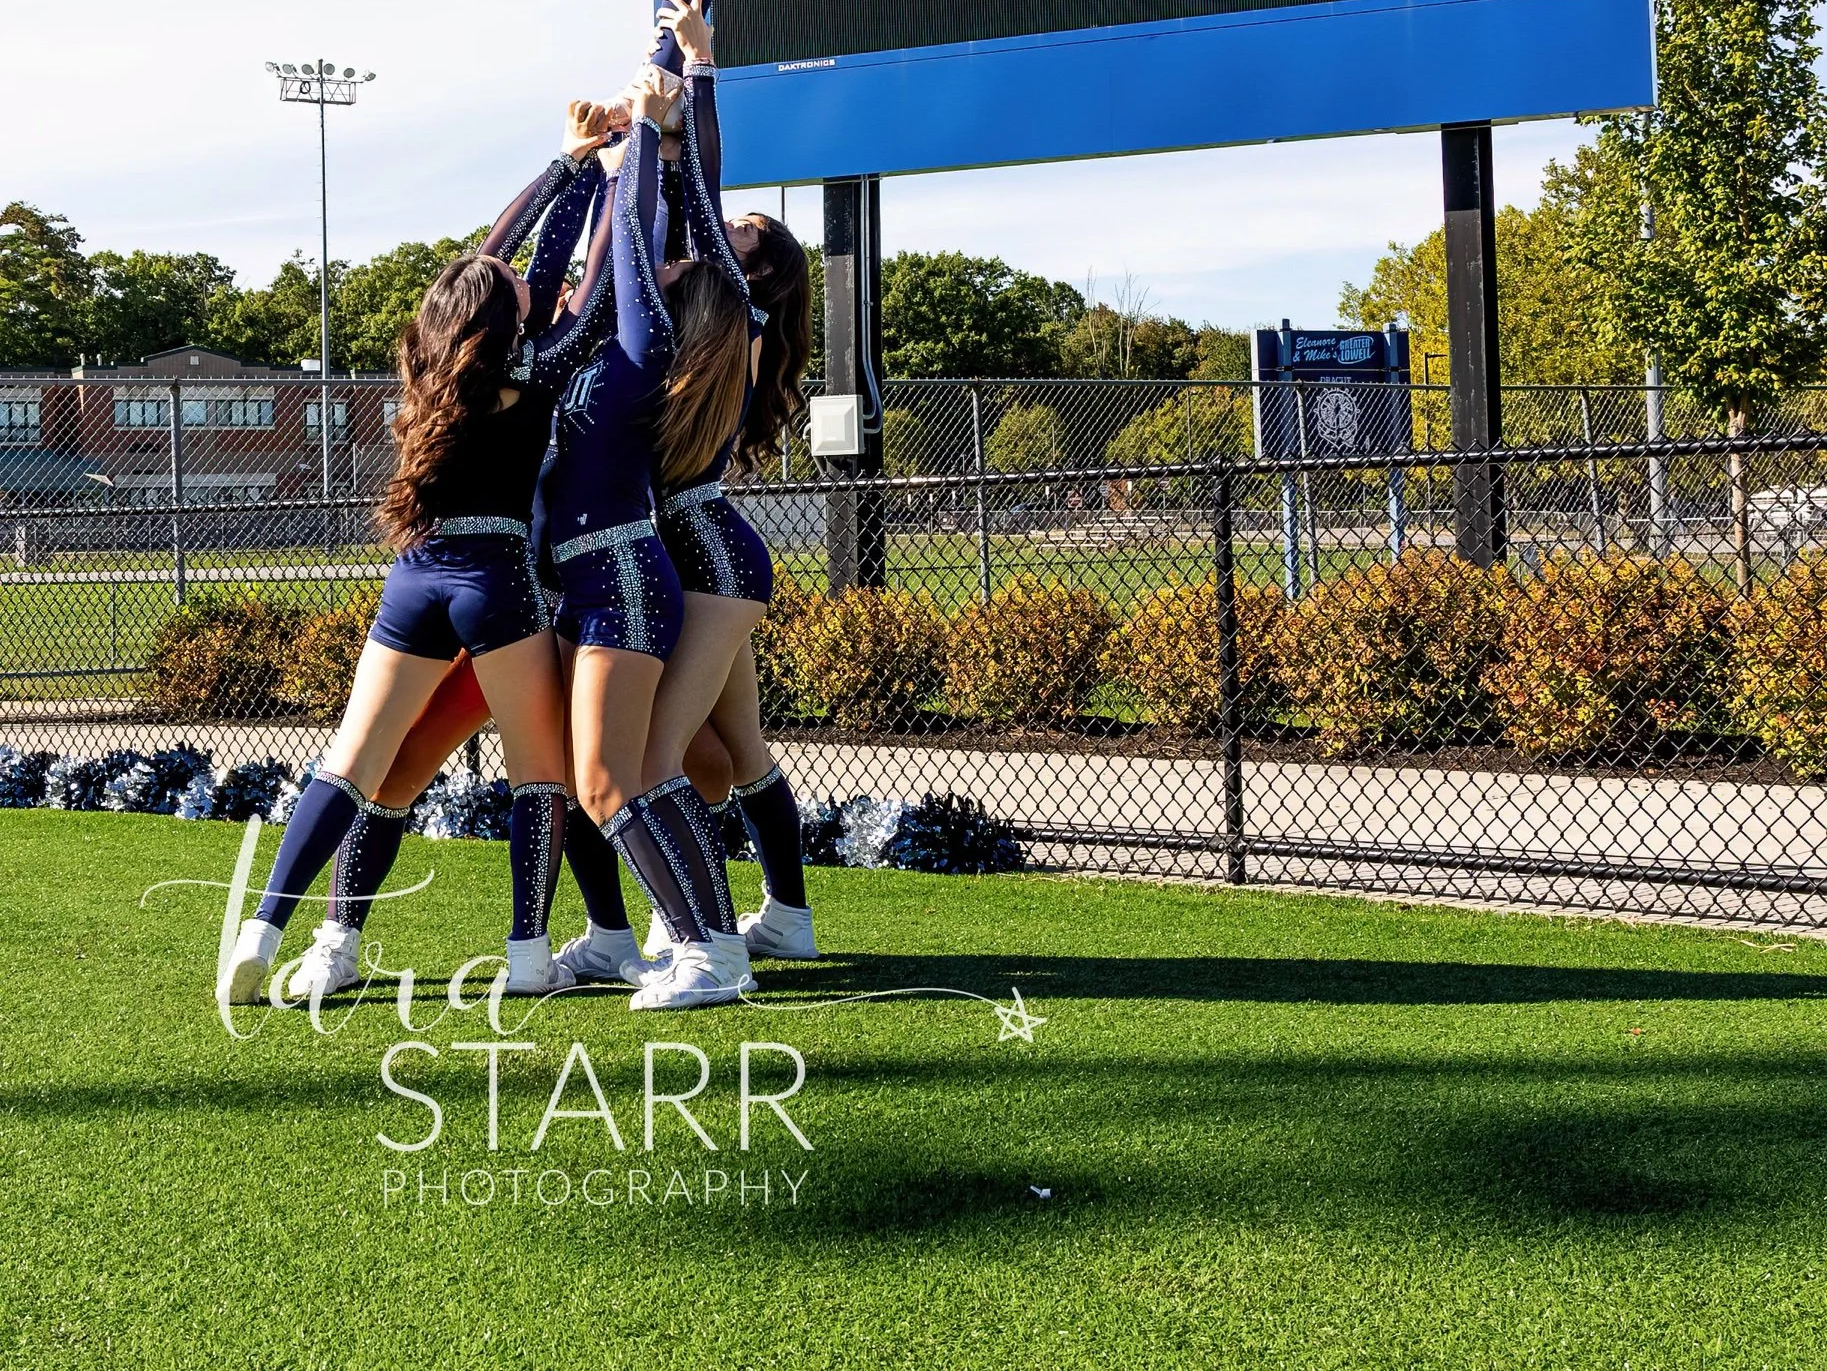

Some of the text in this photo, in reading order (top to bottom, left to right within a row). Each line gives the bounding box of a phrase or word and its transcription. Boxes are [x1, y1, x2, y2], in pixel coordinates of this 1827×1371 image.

[778, 59, 835, 72] DAKTRONICS
[1293, 350, 1300, 362] &
[1341, 348, 1371, 361] LOWELL
